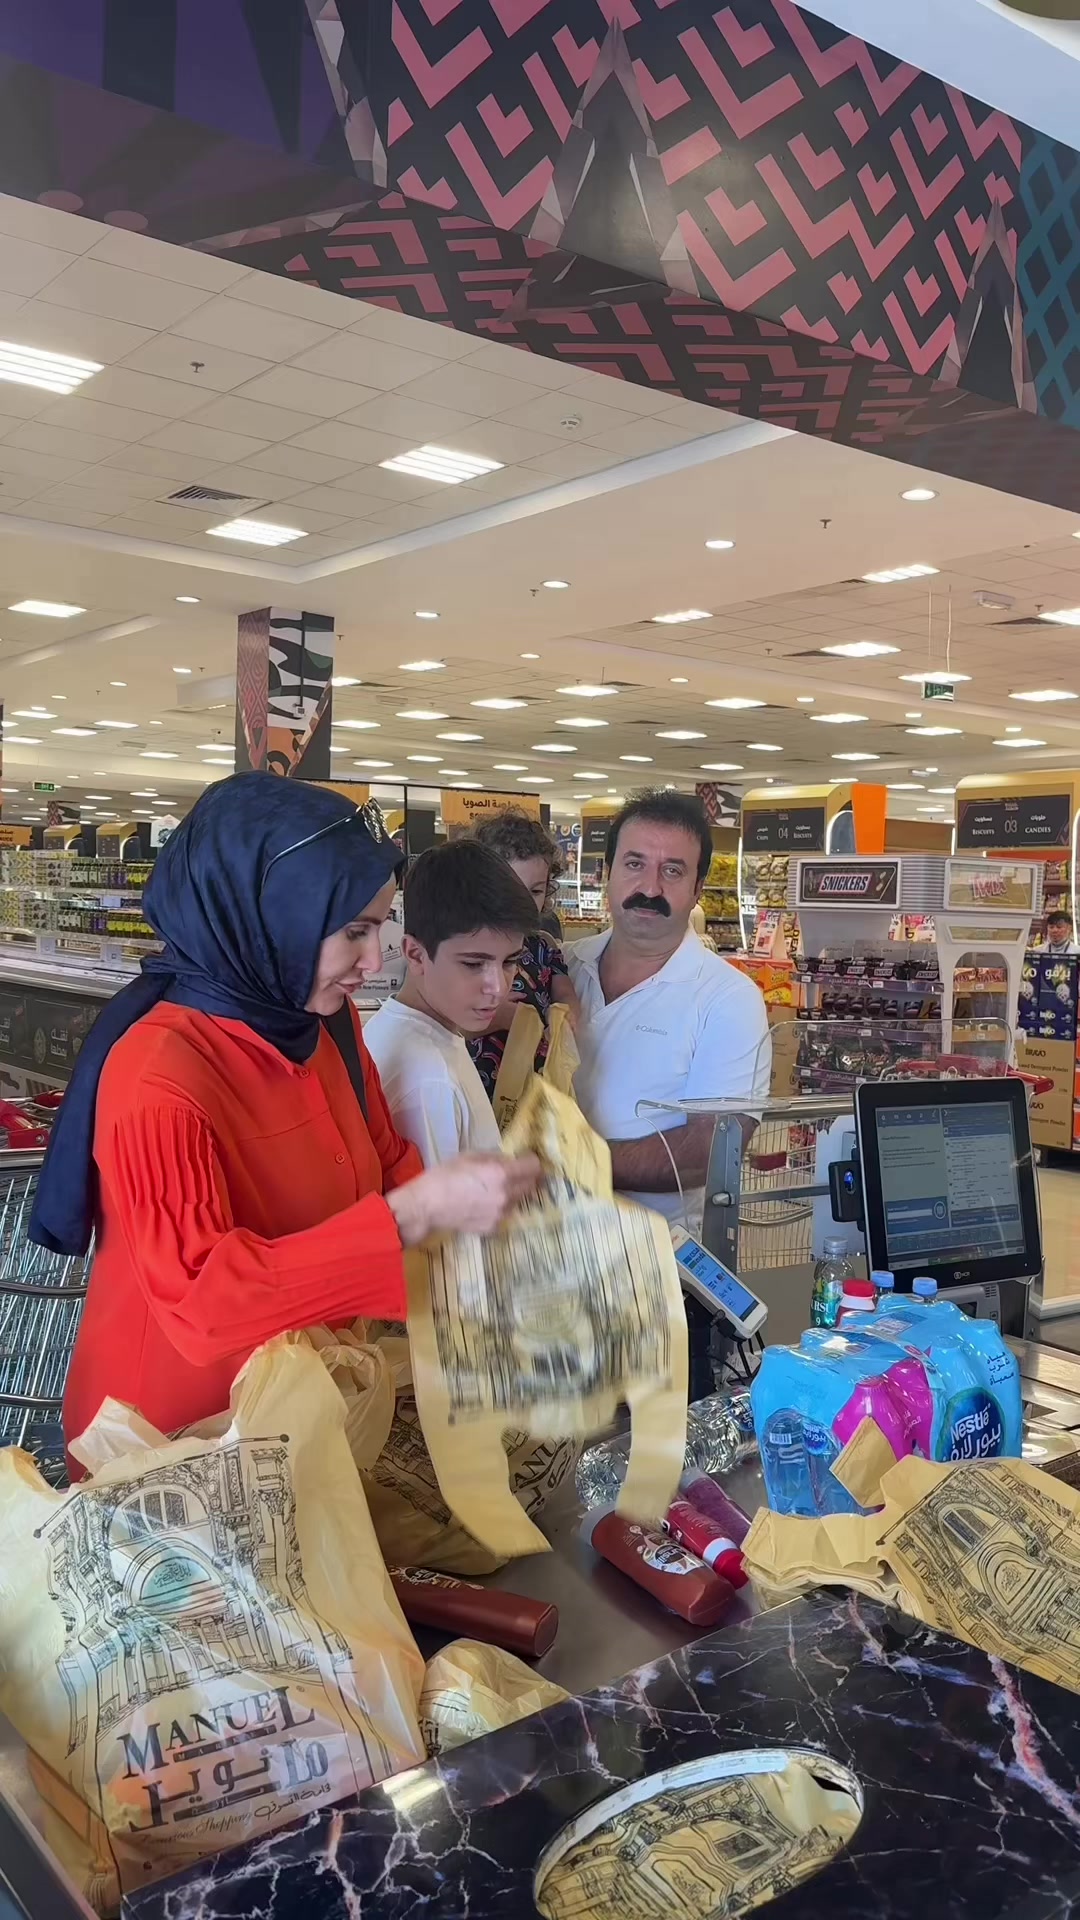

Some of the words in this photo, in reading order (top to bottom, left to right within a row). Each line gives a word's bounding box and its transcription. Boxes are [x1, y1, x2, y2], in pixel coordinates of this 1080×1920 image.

[463, 798, 491, 808] الصويا
[778, 827, 788, 839] 04
[1004, 819, 1017, 833] 03
[1024, 826, 1051, 834] CANDIES
[821, 876, 869, 892] SNICKERS
[950, 1406, 990, 1443] Nestlé
[117, 1685, 315, 1780] MANUEL
[177, 1726, 274, 1761] MARKET
